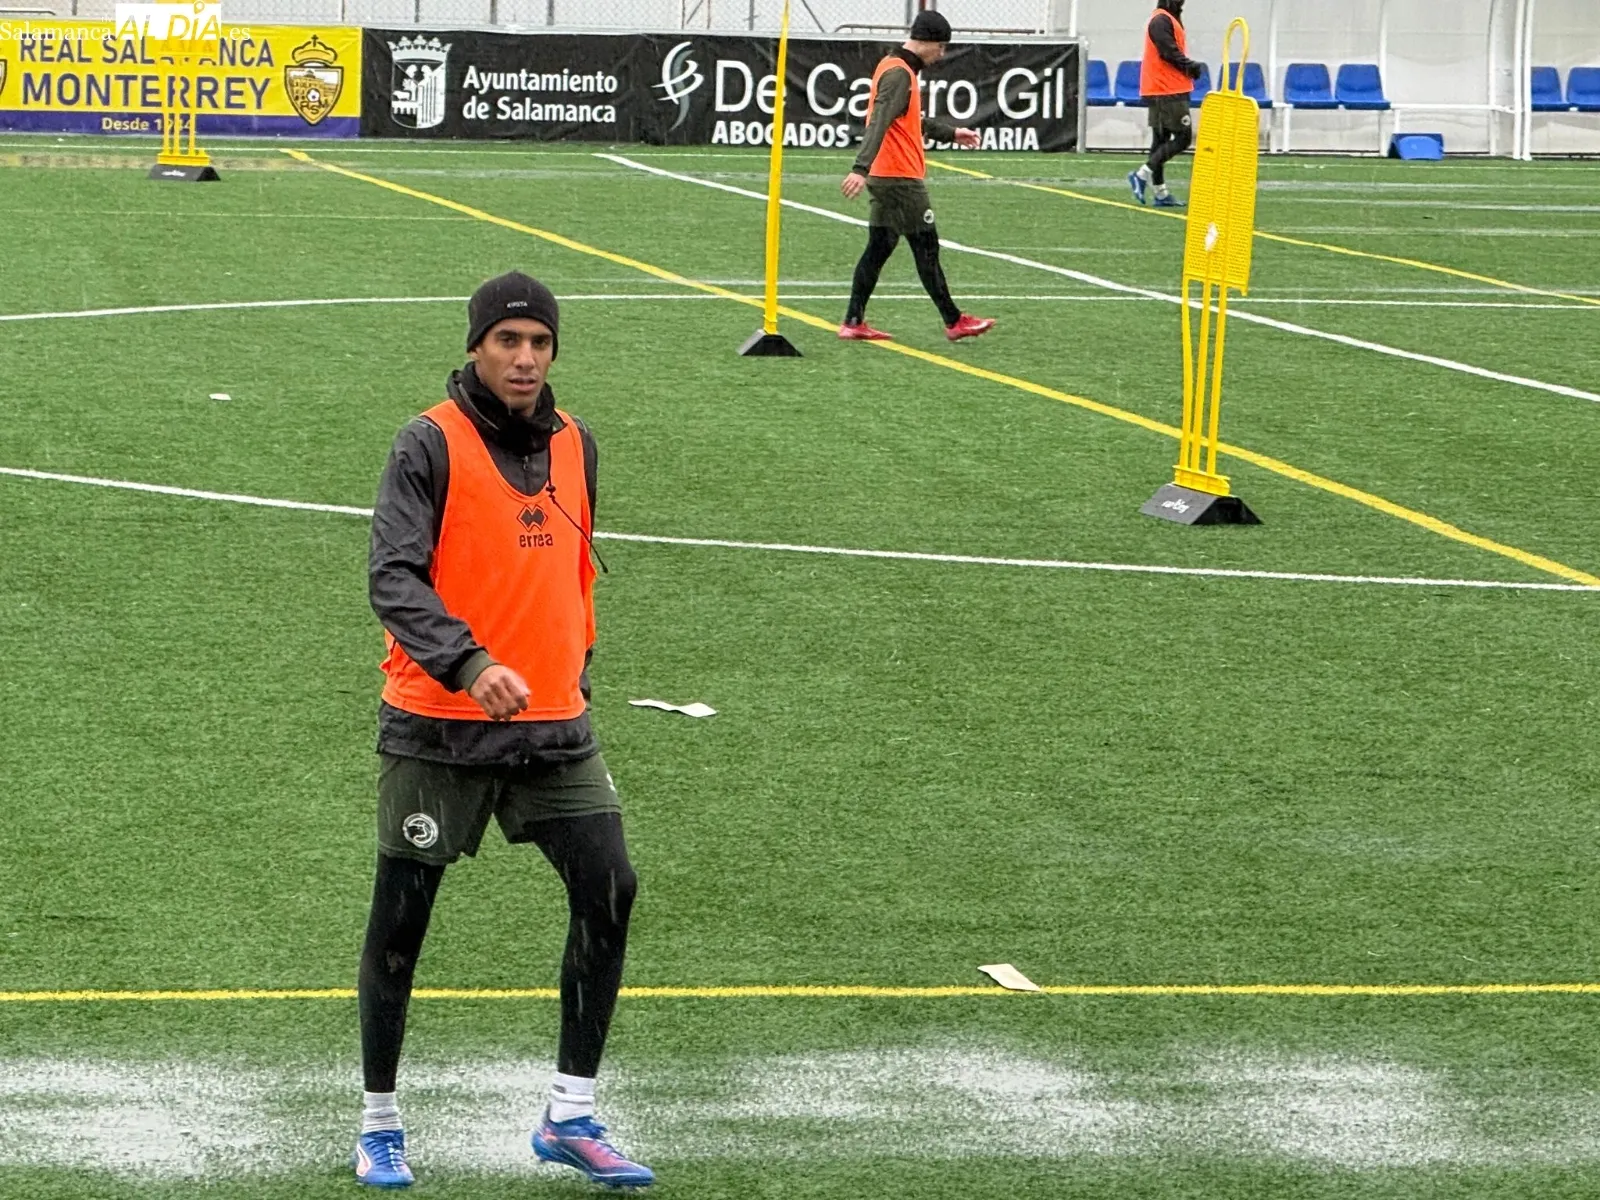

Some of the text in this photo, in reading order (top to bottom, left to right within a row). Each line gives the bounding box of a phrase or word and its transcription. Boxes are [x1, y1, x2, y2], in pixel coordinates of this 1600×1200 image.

[20, 33, 274, 67] REAL SALNCA
[22, 72, 271, 110] MONTERREY
[462, 65, 618, 95] Ayuntamiento
[715, 60, 1064, 119] De Catro Gil
[462, 95, 616, 122] de Salamanca
[102, 117, 149, 131] Desde
[519, 533, 554, 548] errea
